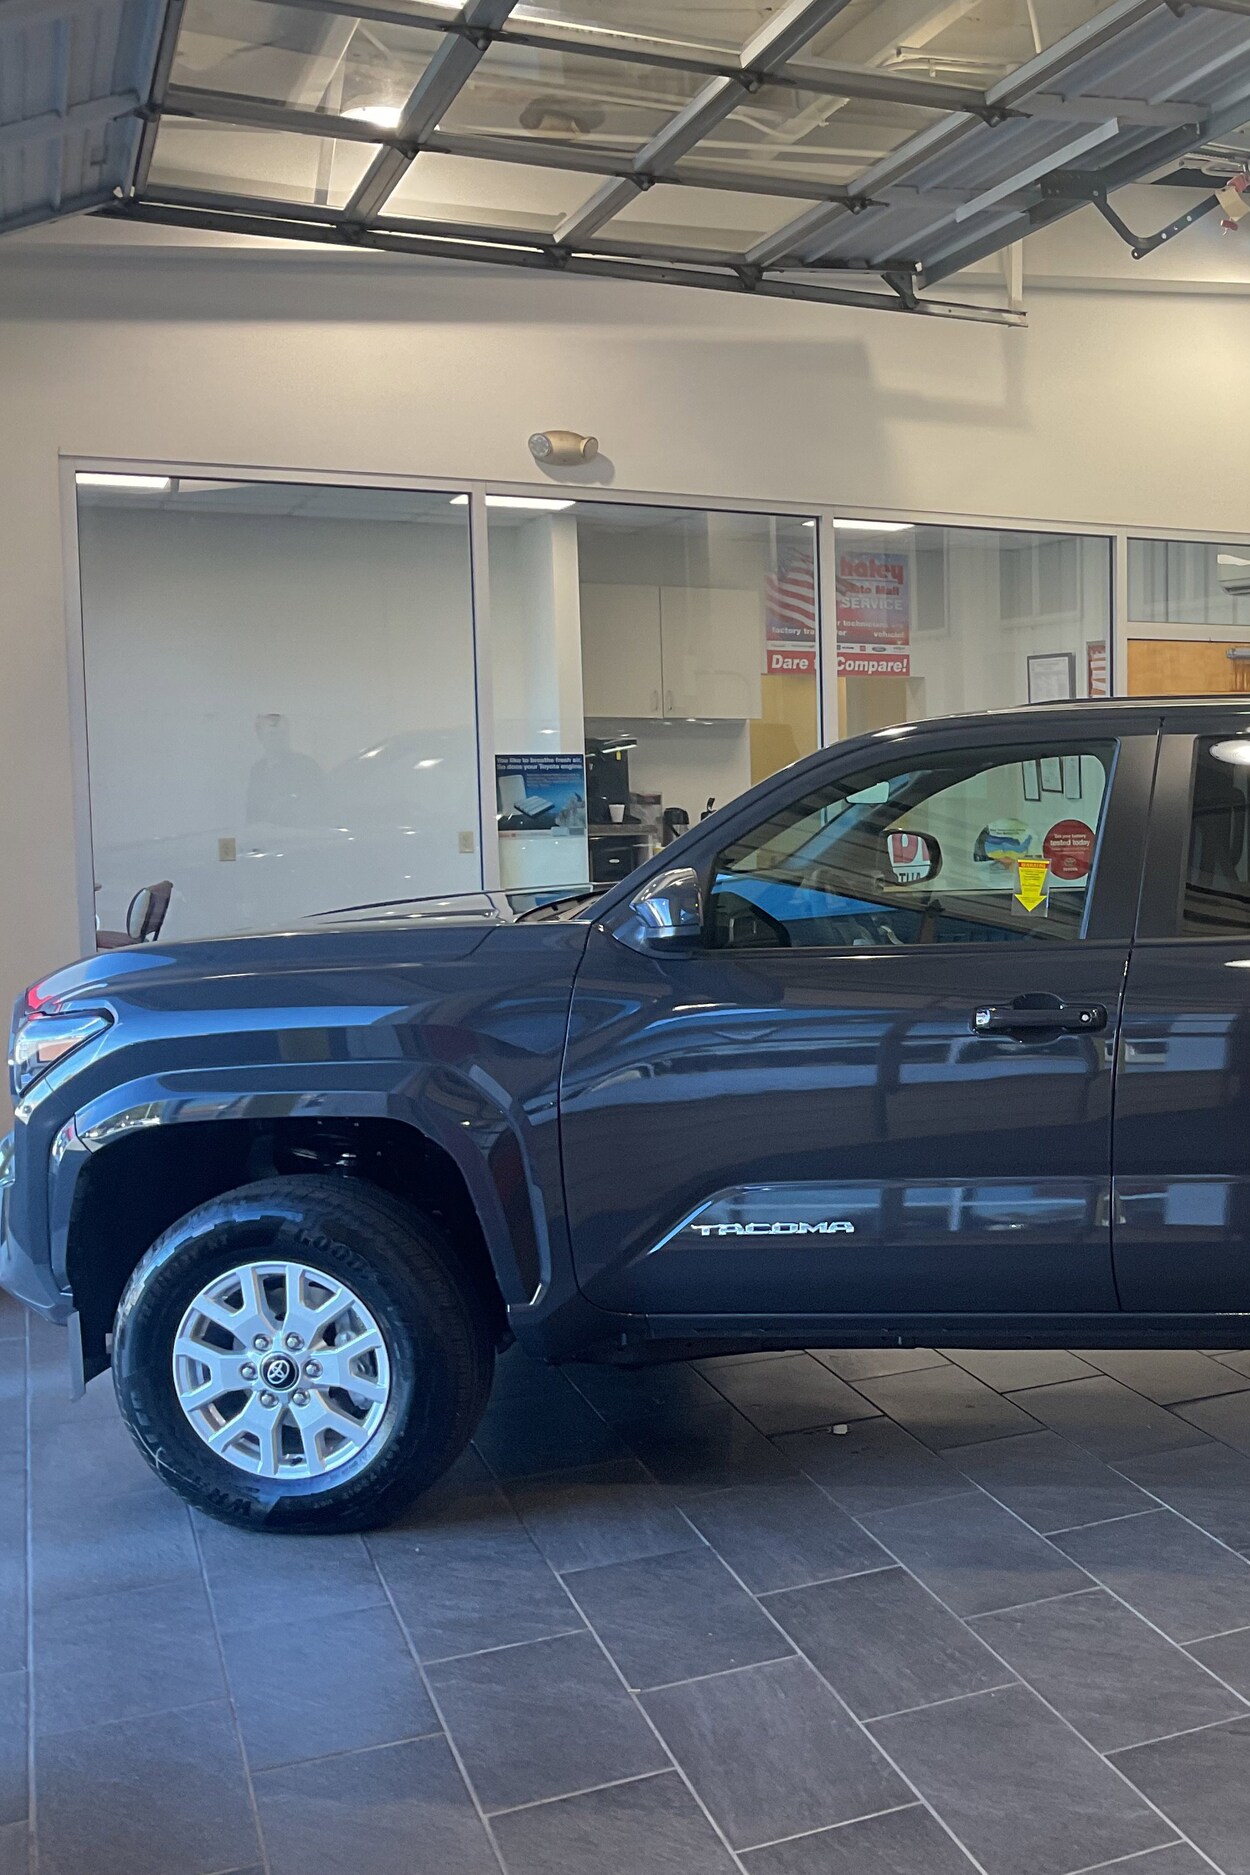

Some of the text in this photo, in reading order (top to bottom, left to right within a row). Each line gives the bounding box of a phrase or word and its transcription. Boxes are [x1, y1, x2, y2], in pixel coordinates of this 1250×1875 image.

[875, 585, 899, 596] Mall
[841, 597, 904, 610] SERVICE
[772, 627, 802, 636] factory
[771, 654, 809, 670] Dare
[837, 657, 908, 674] Compare!
[690, 1221, 855, 1236] TACOMA
